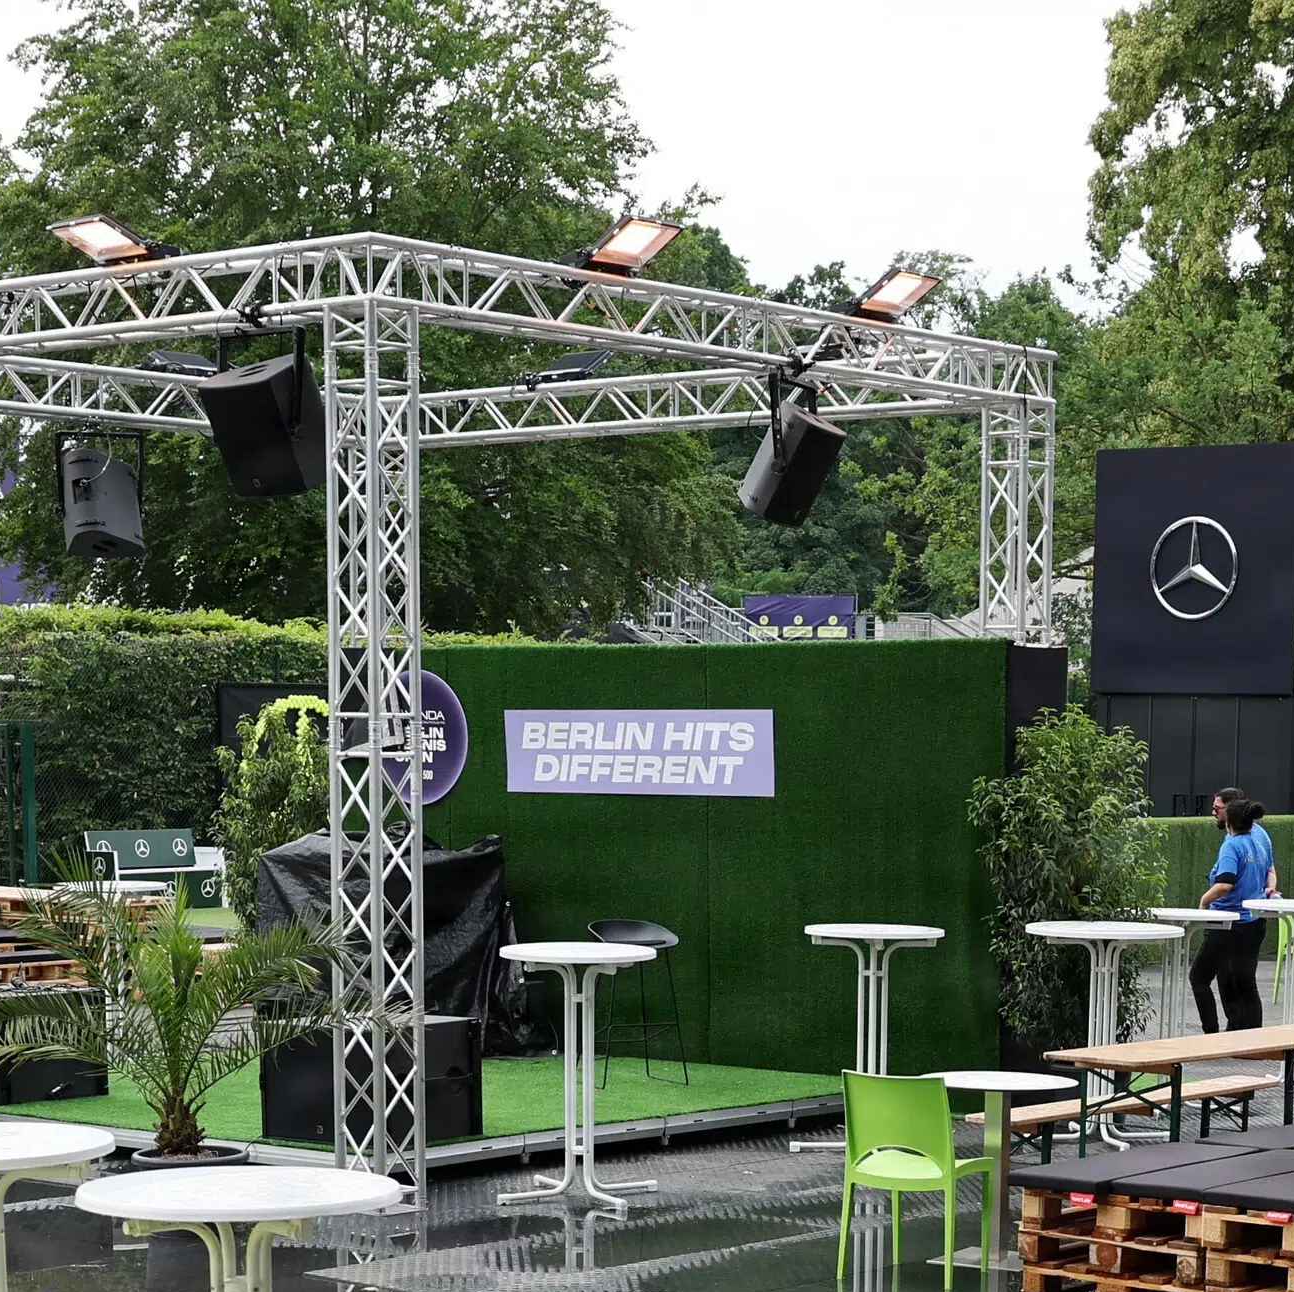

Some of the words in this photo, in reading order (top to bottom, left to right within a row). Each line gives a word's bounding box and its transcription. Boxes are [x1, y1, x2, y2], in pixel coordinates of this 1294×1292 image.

[521, 721, 655, 751] BERLIN
[662, 721, 756, 752] HITS
[533, 754, 744, 786] DIFFERENT
